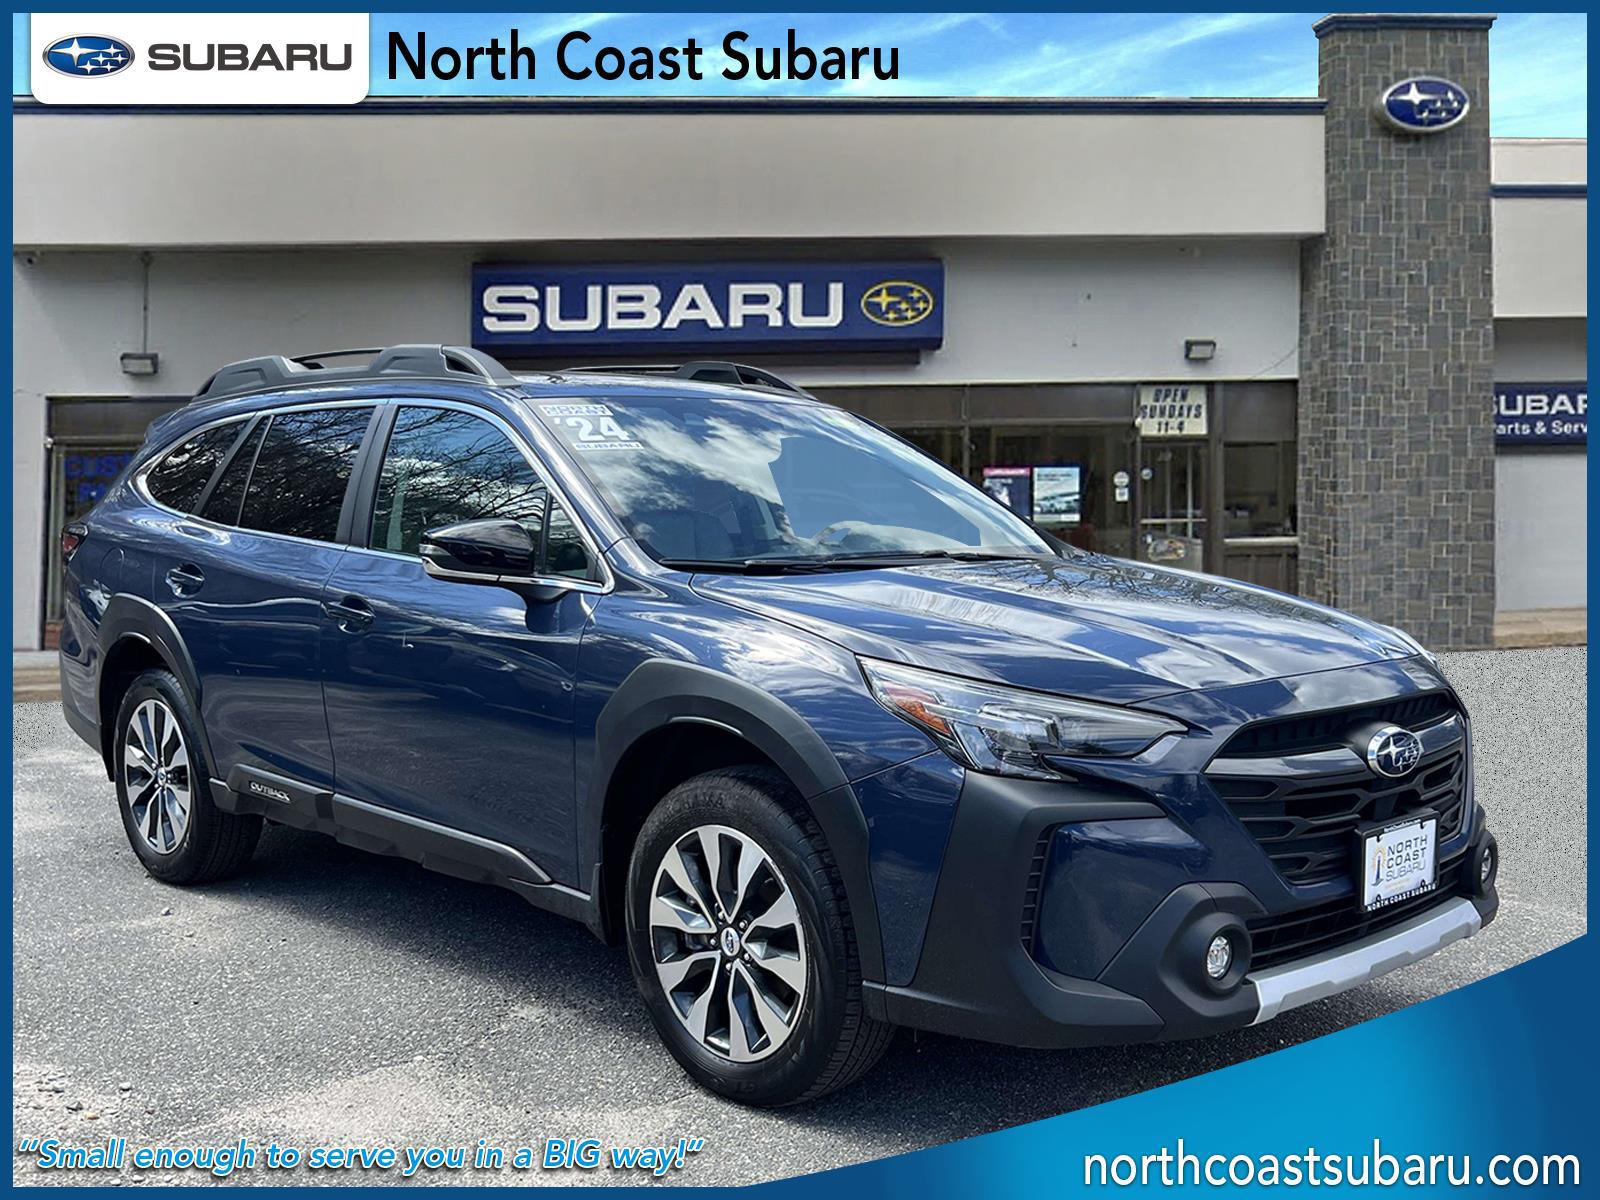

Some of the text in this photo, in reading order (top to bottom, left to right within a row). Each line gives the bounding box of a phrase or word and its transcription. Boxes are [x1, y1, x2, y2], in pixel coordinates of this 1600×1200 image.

[482, 282, 843, 332] SUBARU
[1153, 388, 1189, 403] OPEN
[1493, 394, 1587, 415] UBA
[1140, 404, 1202, 419] SUNDAYS
[1535, 420, 1547, 435] &
[1387, 834, 1428, 857] NORTH
[1387, 847, 1427, 869] COAST
[1385, 859, 1427, 882] SUBARU
[1367, 900, 1389, 912] NORTH
[1390, 891, 1411, 903] COAST
[1412, 883, 1436, 897] SUBARU
